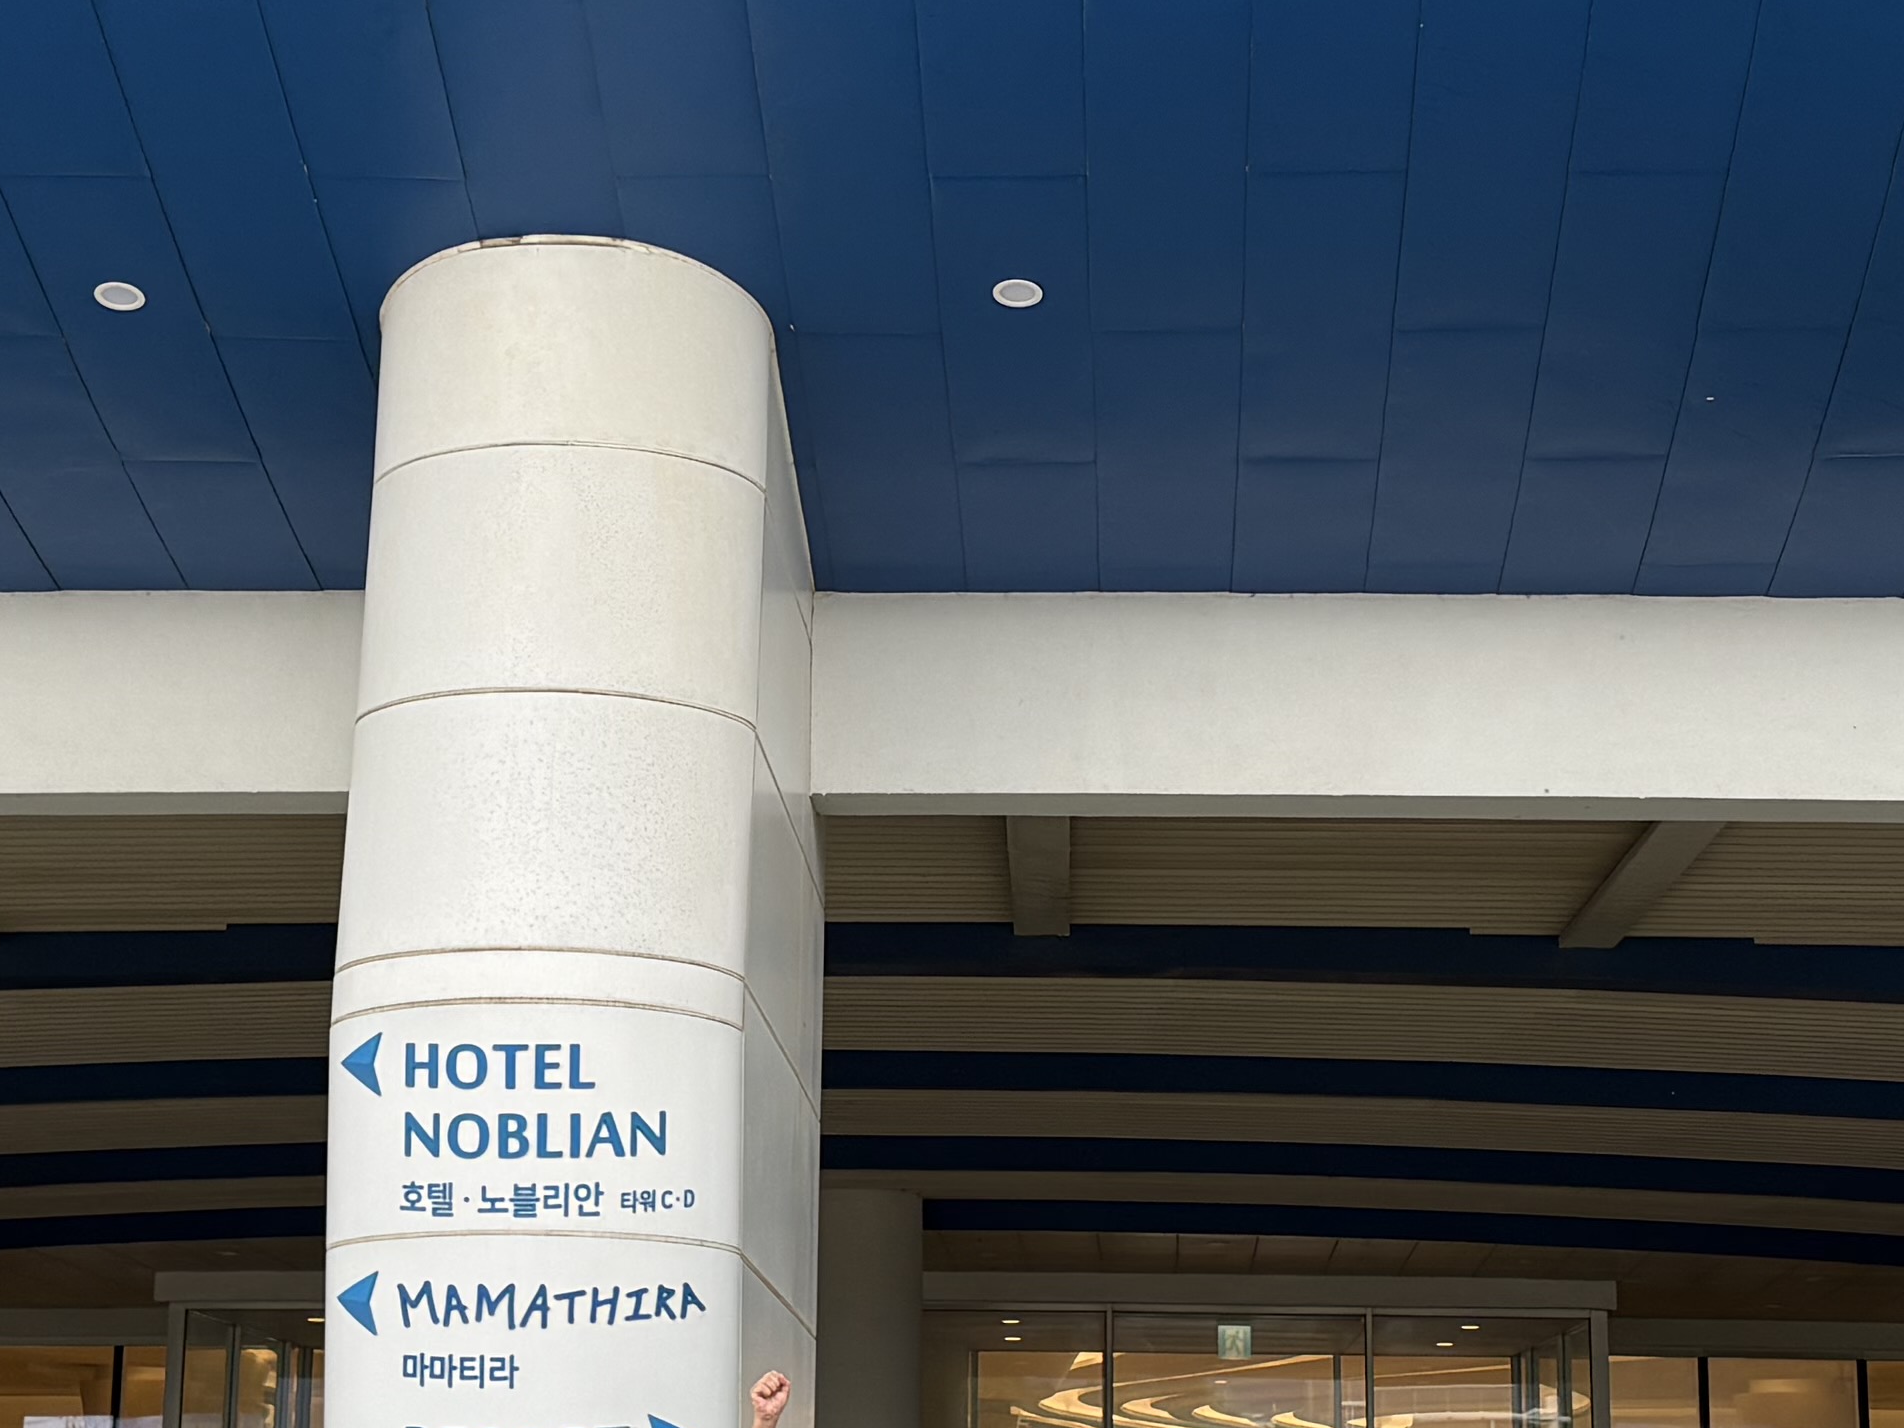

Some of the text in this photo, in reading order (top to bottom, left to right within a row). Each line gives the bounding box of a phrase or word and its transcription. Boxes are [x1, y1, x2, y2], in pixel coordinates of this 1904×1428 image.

[403, 1042, 596, 1090] HOTEL
[403, 1110, 668, 1160] NOBLIAN
[399, 1181, 454, 1217] 호텔
[477, 1181, 605, 1218] 노블리안
[620, 1189, 656, 1214] 타워
[396, 1280, 707, 1331] MAMATHIRA
[402, 1353, 520, 1389] 마마티라
